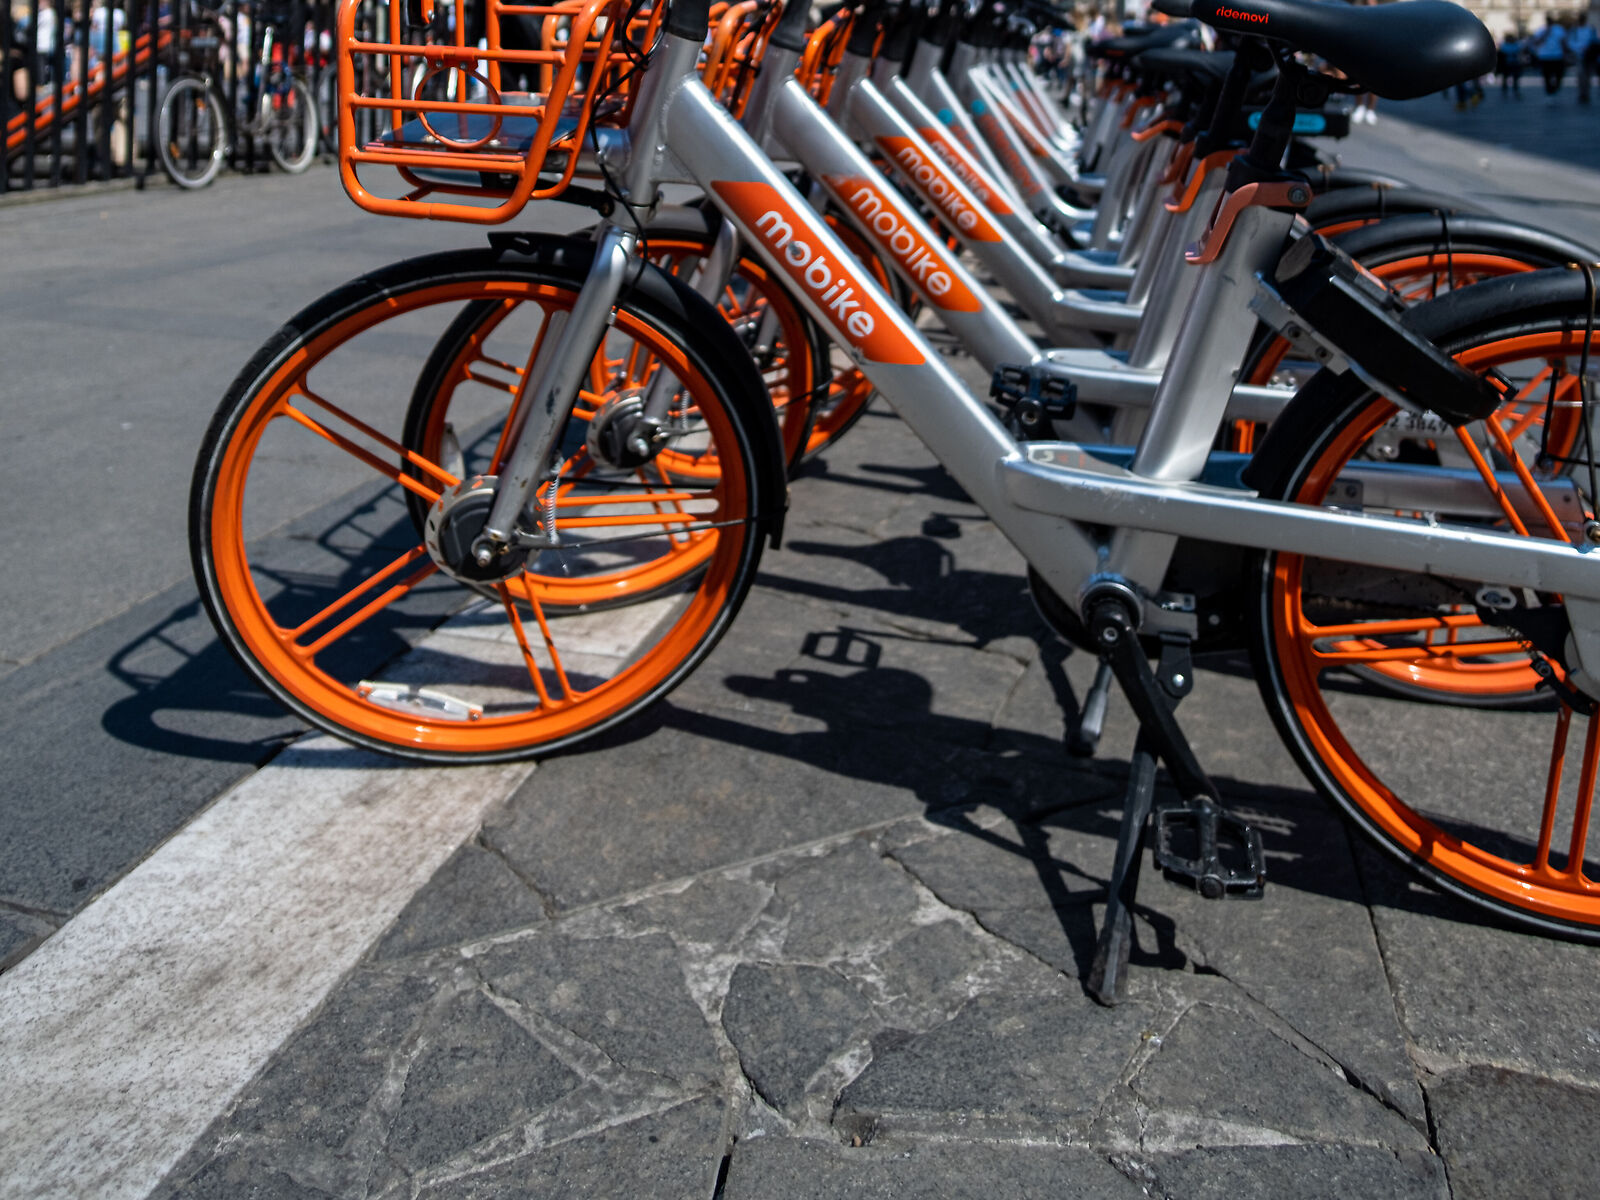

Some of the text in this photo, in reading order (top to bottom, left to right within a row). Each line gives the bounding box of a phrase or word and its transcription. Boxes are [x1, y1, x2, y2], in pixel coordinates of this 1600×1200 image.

[1216, 6, 1269, 24] ridemovi
[897, 147, 978, 230] mobike
[755, 210, 875, 338] mobike
[850, 188, 952, 296] mobike
